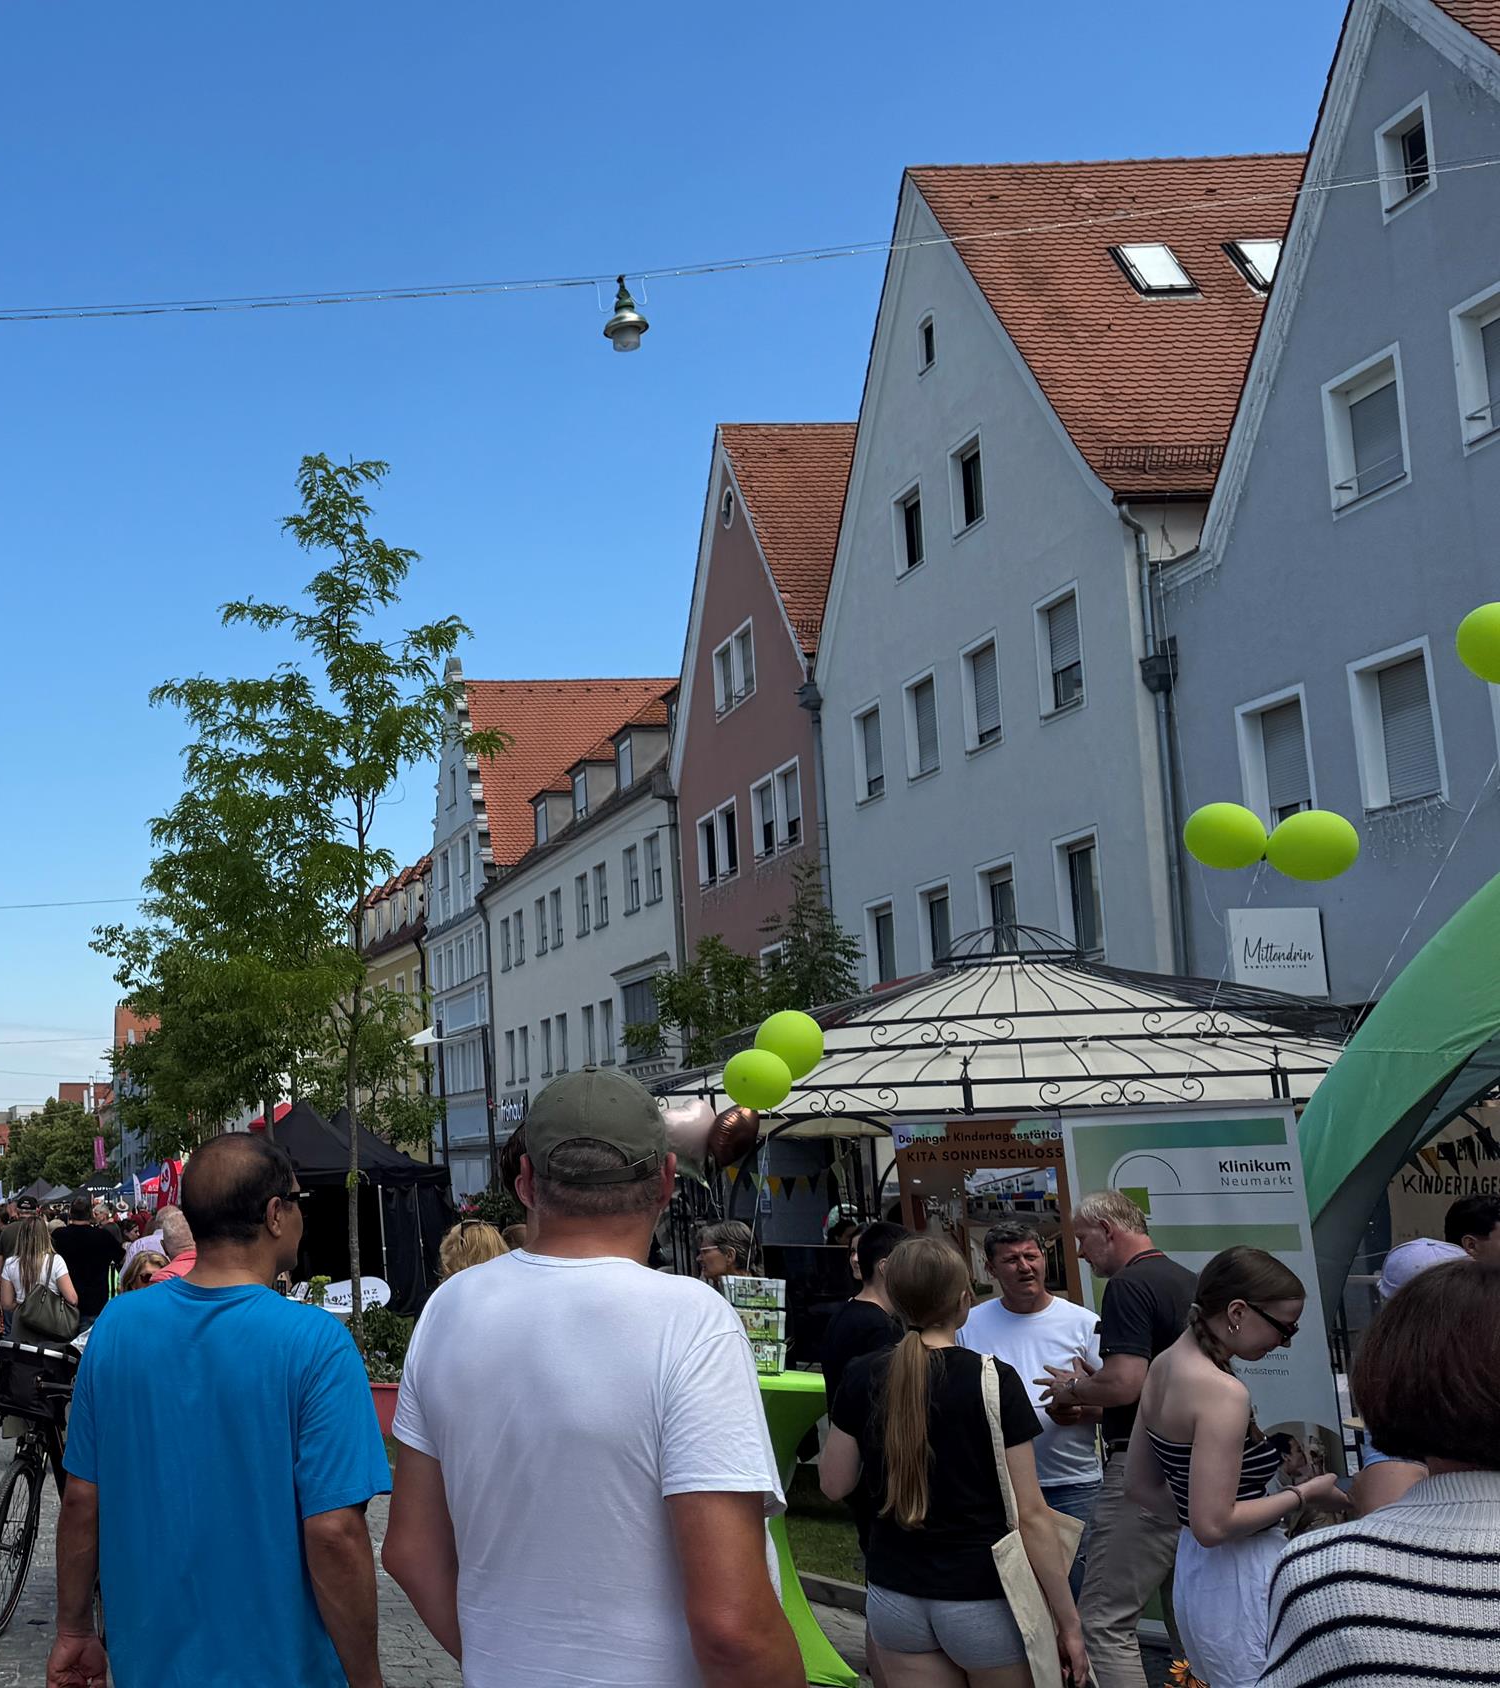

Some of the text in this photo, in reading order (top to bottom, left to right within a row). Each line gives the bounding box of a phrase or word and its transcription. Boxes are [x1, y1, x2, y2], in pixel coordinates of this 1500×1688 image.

[1243, 936, 1315, 965] Mittendrin
[898, 1134, 950, 1145] Deininger
[907, 1147, 1064, 1163] KITA SONNENSCHLOSS
[1219, 1160, 1291, 1172] Klinikum
[1221, 1175, 1293, 1187] Neumarkt
[1401, 1174, 1500, 1196] KINDERTAGE
